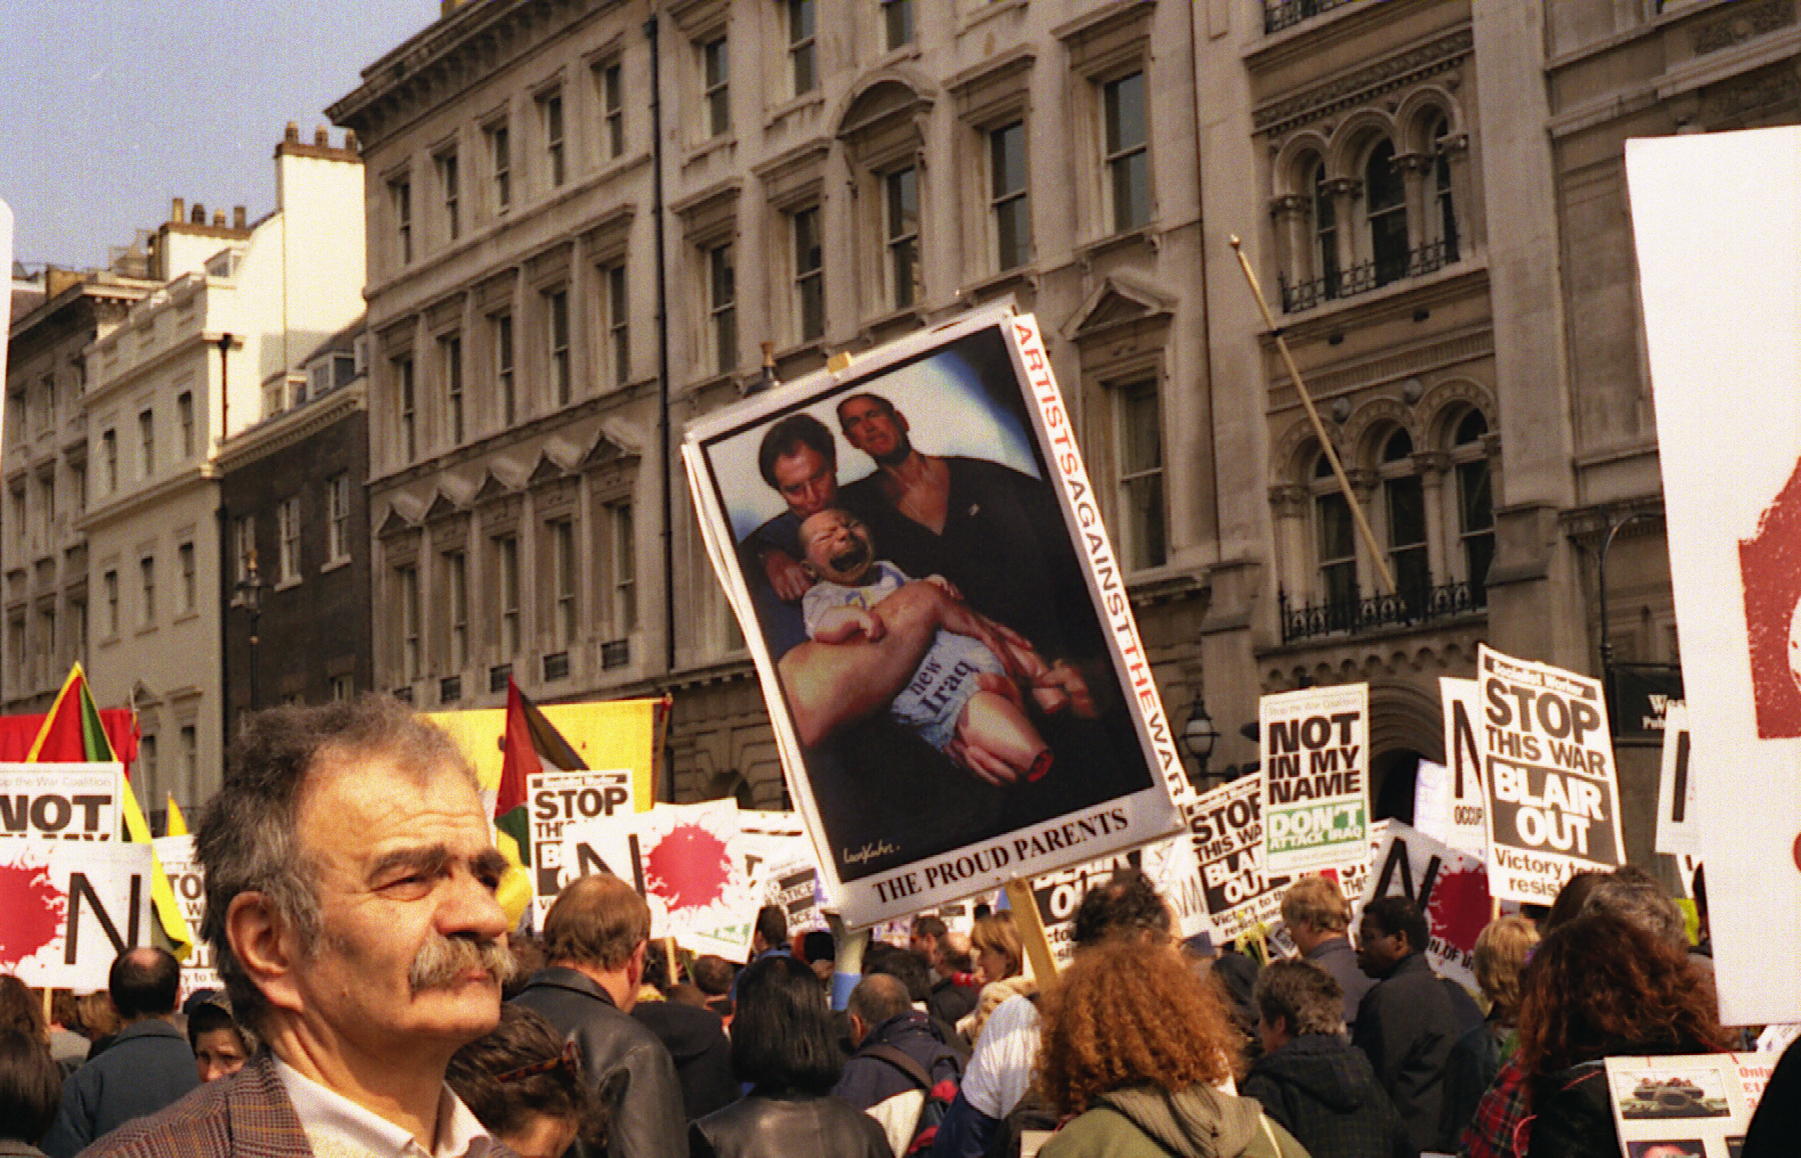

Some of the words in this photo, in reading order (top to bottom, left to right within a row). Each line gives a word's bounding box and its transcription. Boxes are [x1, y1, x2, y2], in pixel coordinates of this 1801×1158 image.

[919, 661, 981, 714] Iraq
[1486, 677, 1601, 745] STOP
[1269, 711, 1360, 755] NOT
[1486, 724, 1542, 761] THIS
[1549, 739, 1606, 777] WAR
[1269, 753, 1300, 780] IN
[1310, 745, 1360, 774] MY
[535, 787, 628, 820] STOP
[1269, 770, 1360, 805] NAME
[1492, 761, 1604, 821] BLAIR
[0, 795, 112, 832] NOT
[1516, 806, 1590, 855] OUT
[872, 871, 922, 903] THE
[925, 849, 1010, 888] PROUD
[1013, 807, 1128, 861] PARENTS
[1194, 836, 1234, 862] THIS
[1237, 824, 1262, 845] WA
[1204, 848, 1262, 888] BLAI
[1494, 847, 1563, 880] Victory
[166, 873, 204, 901] TO
[1259, 894, 1272, 908] to
[1509, 877, 1566, 896] resis
